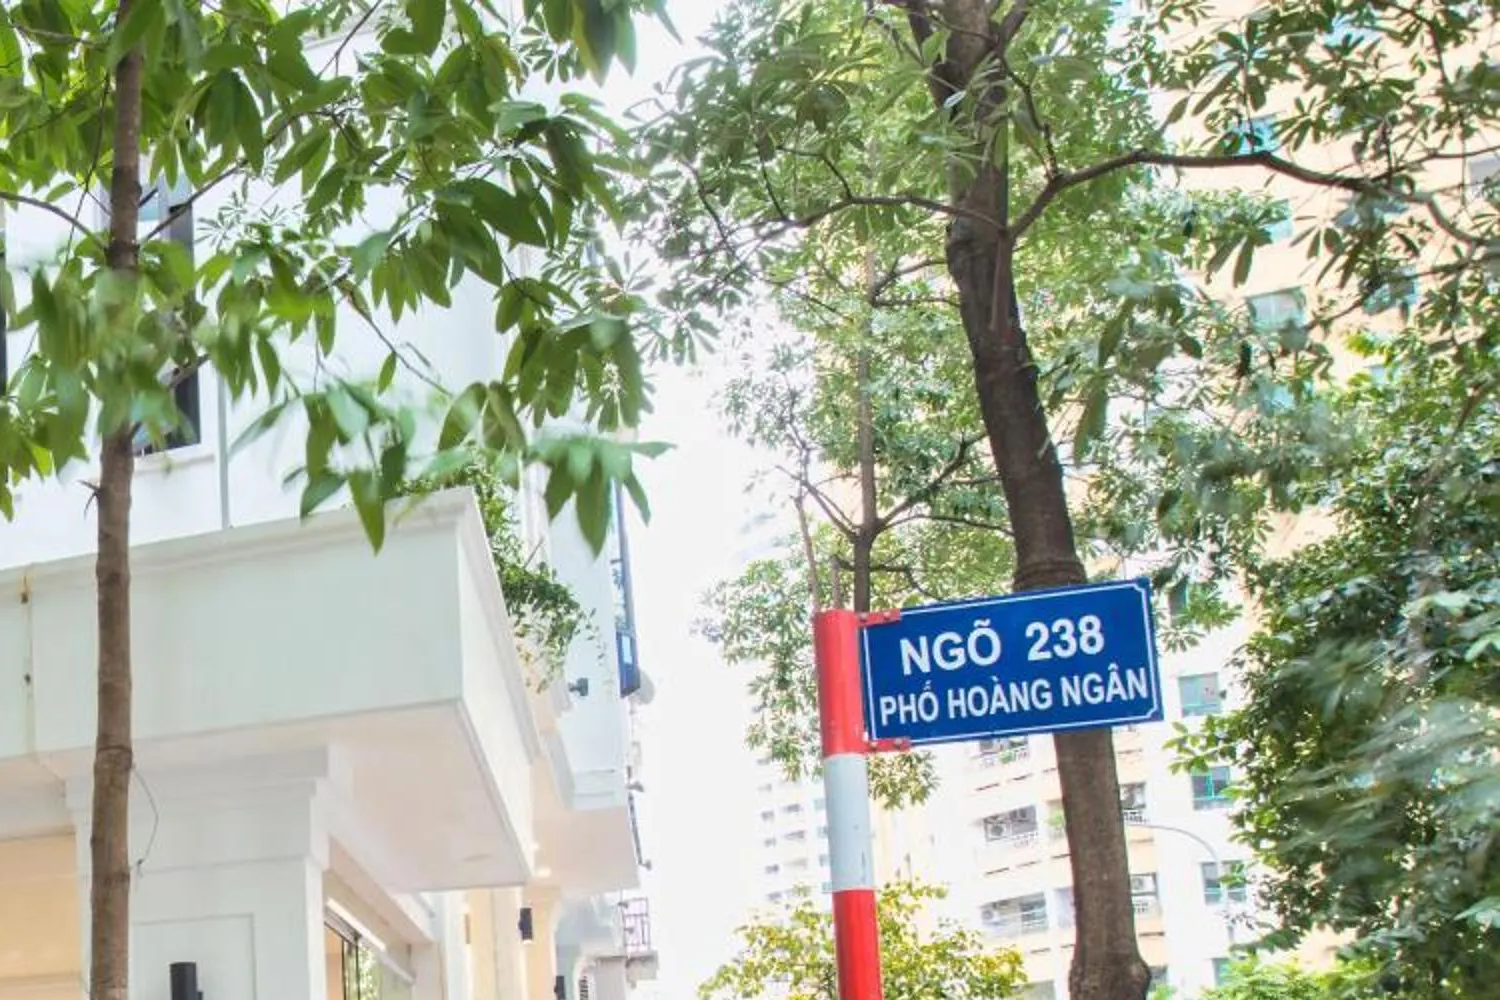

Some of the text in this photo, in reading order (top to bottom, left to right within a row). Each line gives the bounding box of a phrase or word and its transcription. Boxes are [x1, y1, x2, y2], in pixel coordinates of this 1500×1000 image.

[900, 615, 1105, 675] NGÕ 238
[879, 663, 1148, 726] PHỐ HOÀNG NGÂN
